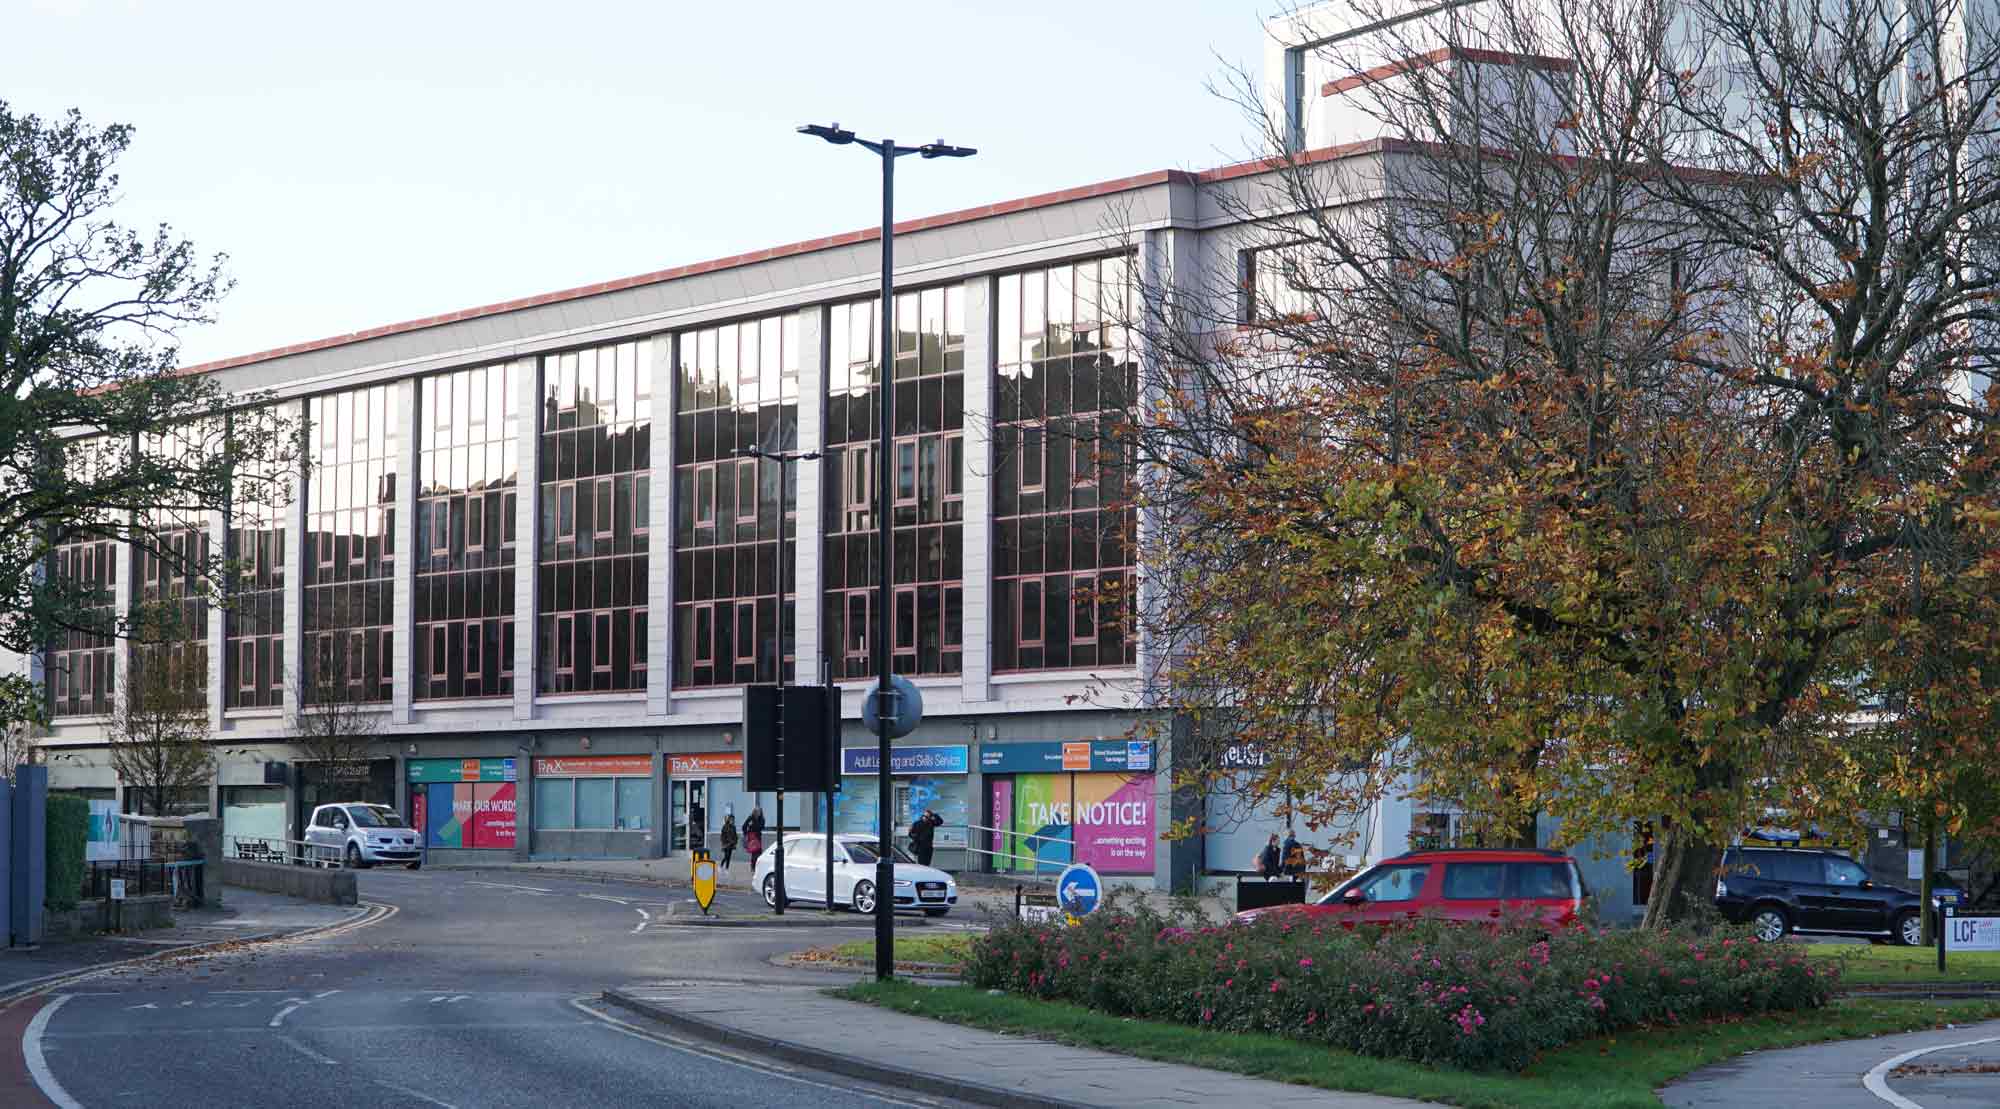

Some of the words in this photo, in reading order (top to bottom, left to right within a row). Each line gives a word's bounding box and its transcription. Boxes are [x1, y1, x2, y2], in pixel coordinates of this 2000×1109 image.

[854, 755, 871, 768] Adult
[1028, 801, 1070, 826] TAKE
[1076, 801, 1147, 826] NOTICE!
[1953, 920, 1977, 942] LCF
